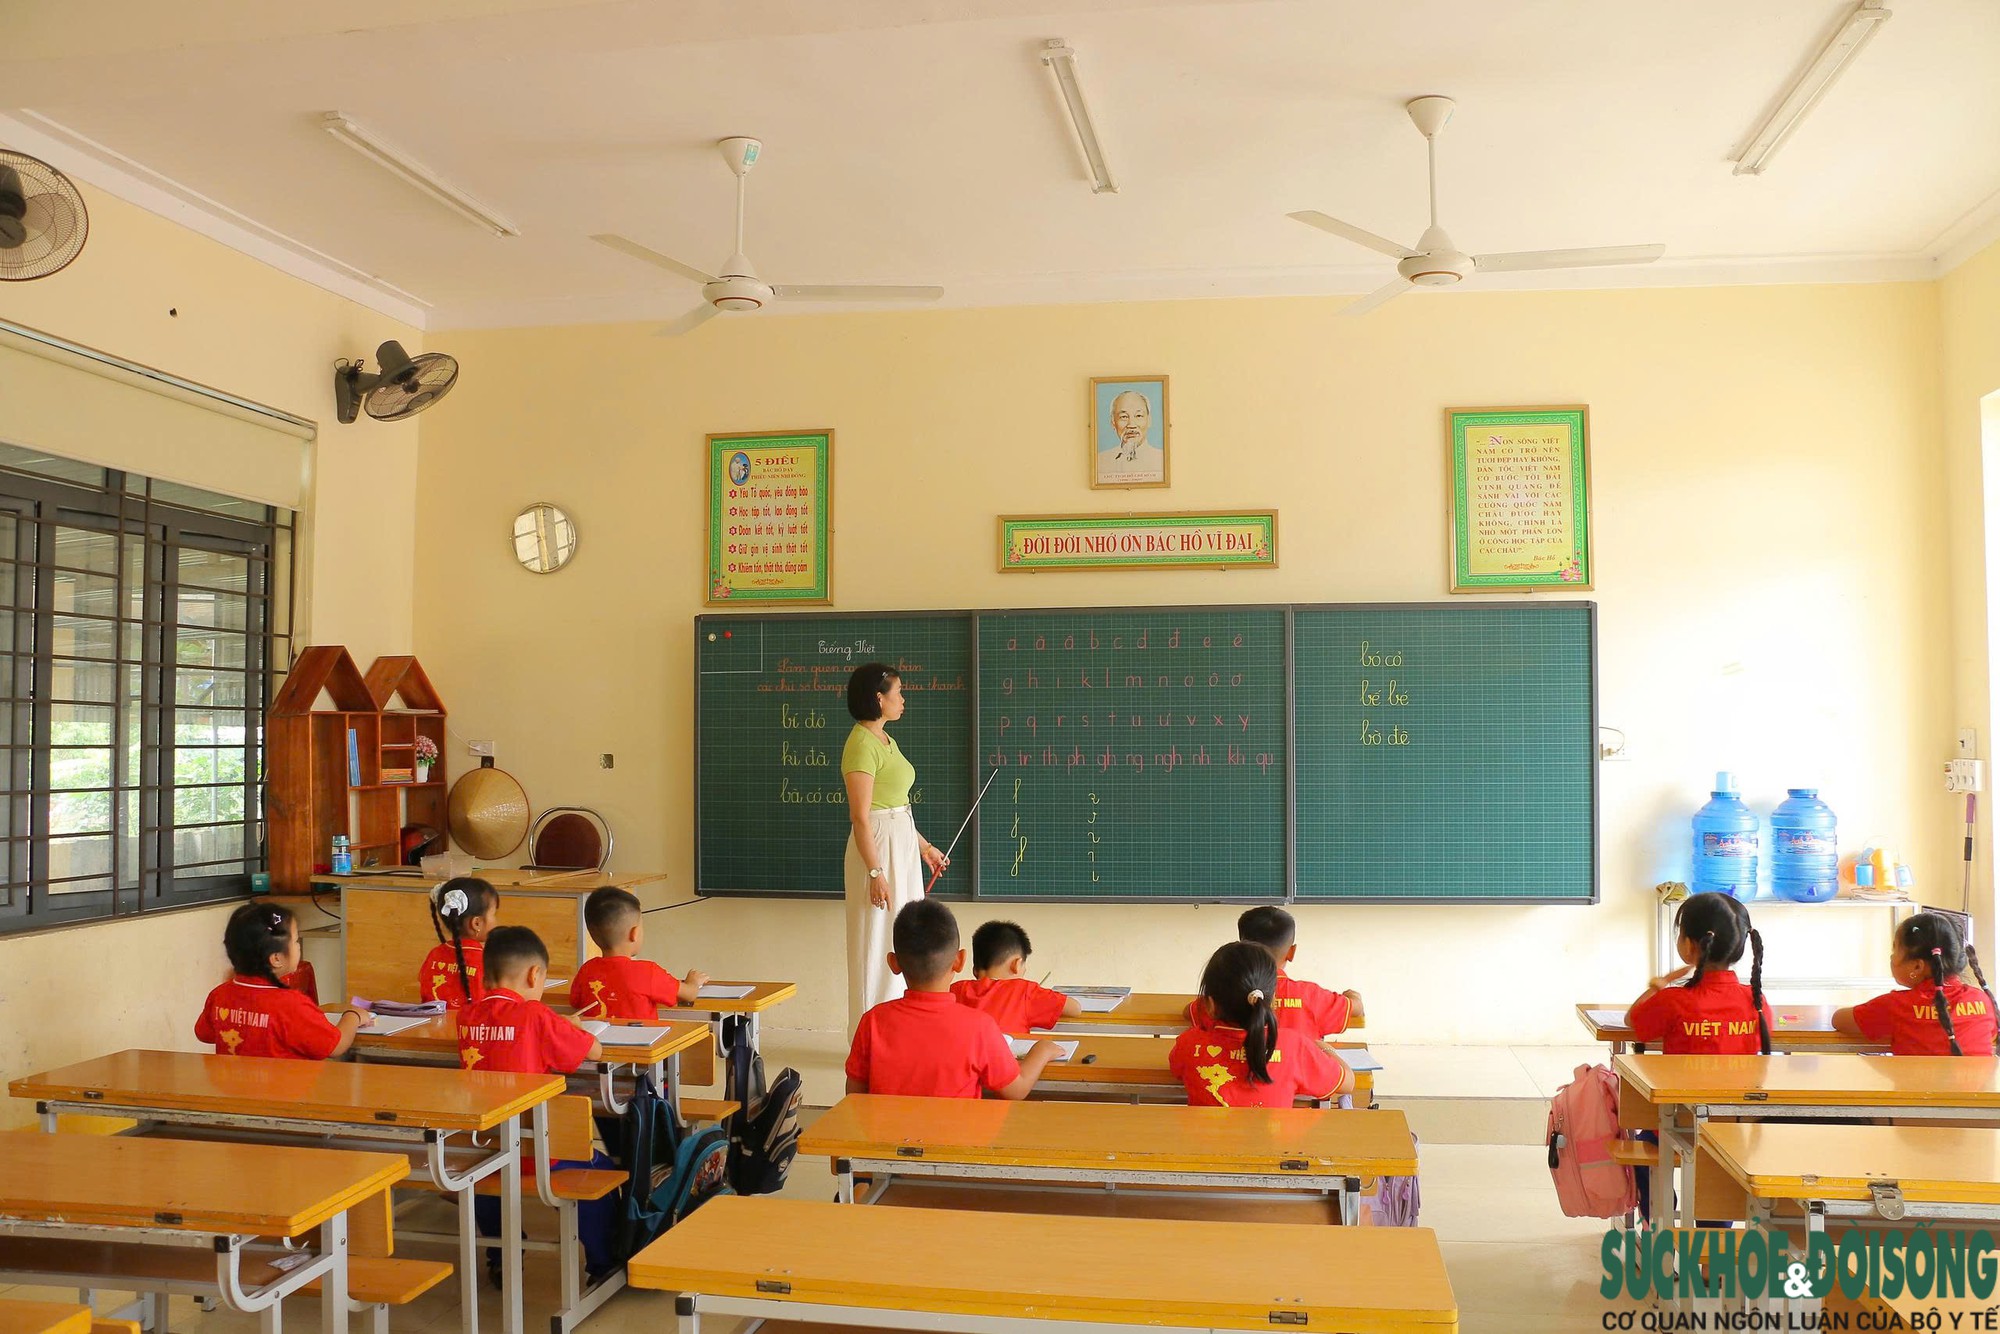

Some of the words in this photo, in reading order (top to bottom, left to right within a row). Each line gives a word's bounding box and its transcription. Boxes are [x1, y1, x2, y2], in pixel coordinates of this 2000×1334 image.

[755, 458, 761, 466] 5
[1023, 536, 1051, 554] ĐỜI
[1054, 535, 1080, 553] ĐỜI
[1084, 532, 1117, 553] NHỚ
[1120, 534, 1142, 552] ƠN
[1146, 531, 1176, 552] BÁC
[1180, 529, 1202, 550] HỒ
[1206, 531, 1222, 550] VĨ
[1226, 532, 1253, 553] ĐẠI
[818, 640, 853, 660] Tiếng
[855, 639, 876, 654] Việt
[1007, 638, 1017, 650] a
[1091, 628, 1099, 649] b
[1113, 637, 1122, 648] c
[1137, 628, 1147, 649] d
[1169, 628, 1180, 648] đ
[1203, 636, 1212, 648] e
[1234, 634, 1243, 648] ê
[1360, 641, 1381, 667] bó
[1385, 650, 1402, 667] cỏ
[1003, 677, 1013, 694] g
[1028, 668, 1038, 688] h
[1082, 668, 1092, 688] k
[1126, 675, 1142, 687] m
[1159, 675, 1168, 687] n
[1184, 675, 1193, 687] o
[1209, 672, 1219, 687] ô
[1232, 672, 1242, 687] ơ
[1387, 679, 1409, 706] bé
[781, 703, 799, 728] bí
[805, 708, 826, 728] đỏ
[1000, 716, 1010, 736] p
[1027, 715, 1037, 736] q
[1057, 716, 1066, 727] r
[1082, 713, 1089, 727] s
[1108, 711, 1116, 726] t
[1132, 715, 1141, 726] u
[1160, 713, 1171, 726] ư
[1187, 715, 1197, 726] v
[1214, 714, 1224, 726] x
[1239, 714, 1249, 732] y
[989, 746, 1006, 766] ch
[1017, 750, 1032, 766] tr
[1042, 746, 1057, 765] th
[1067, 746, 1085, 774] ph
[1097, 746, 1116, 773] gh
[1126, 753, 1143, 773] ng
[1155, 746, 1182, 773] ngh
[1192, 746, 1210, 764] nh
[1228, 745, 1245, 764] kh
[1256, 752, 1274, 775] qu
[215, 1006, 219, 1020] I
[1284, 998, 1302, 1008] NAM
[1956, 1001, 1986, 1016] NAM
[1683, 1019, 1722, 1040] VIỆT
[1194, 1044, 1201, 1057] I
[1230, 1047, 1247, 1063] VIỆ
